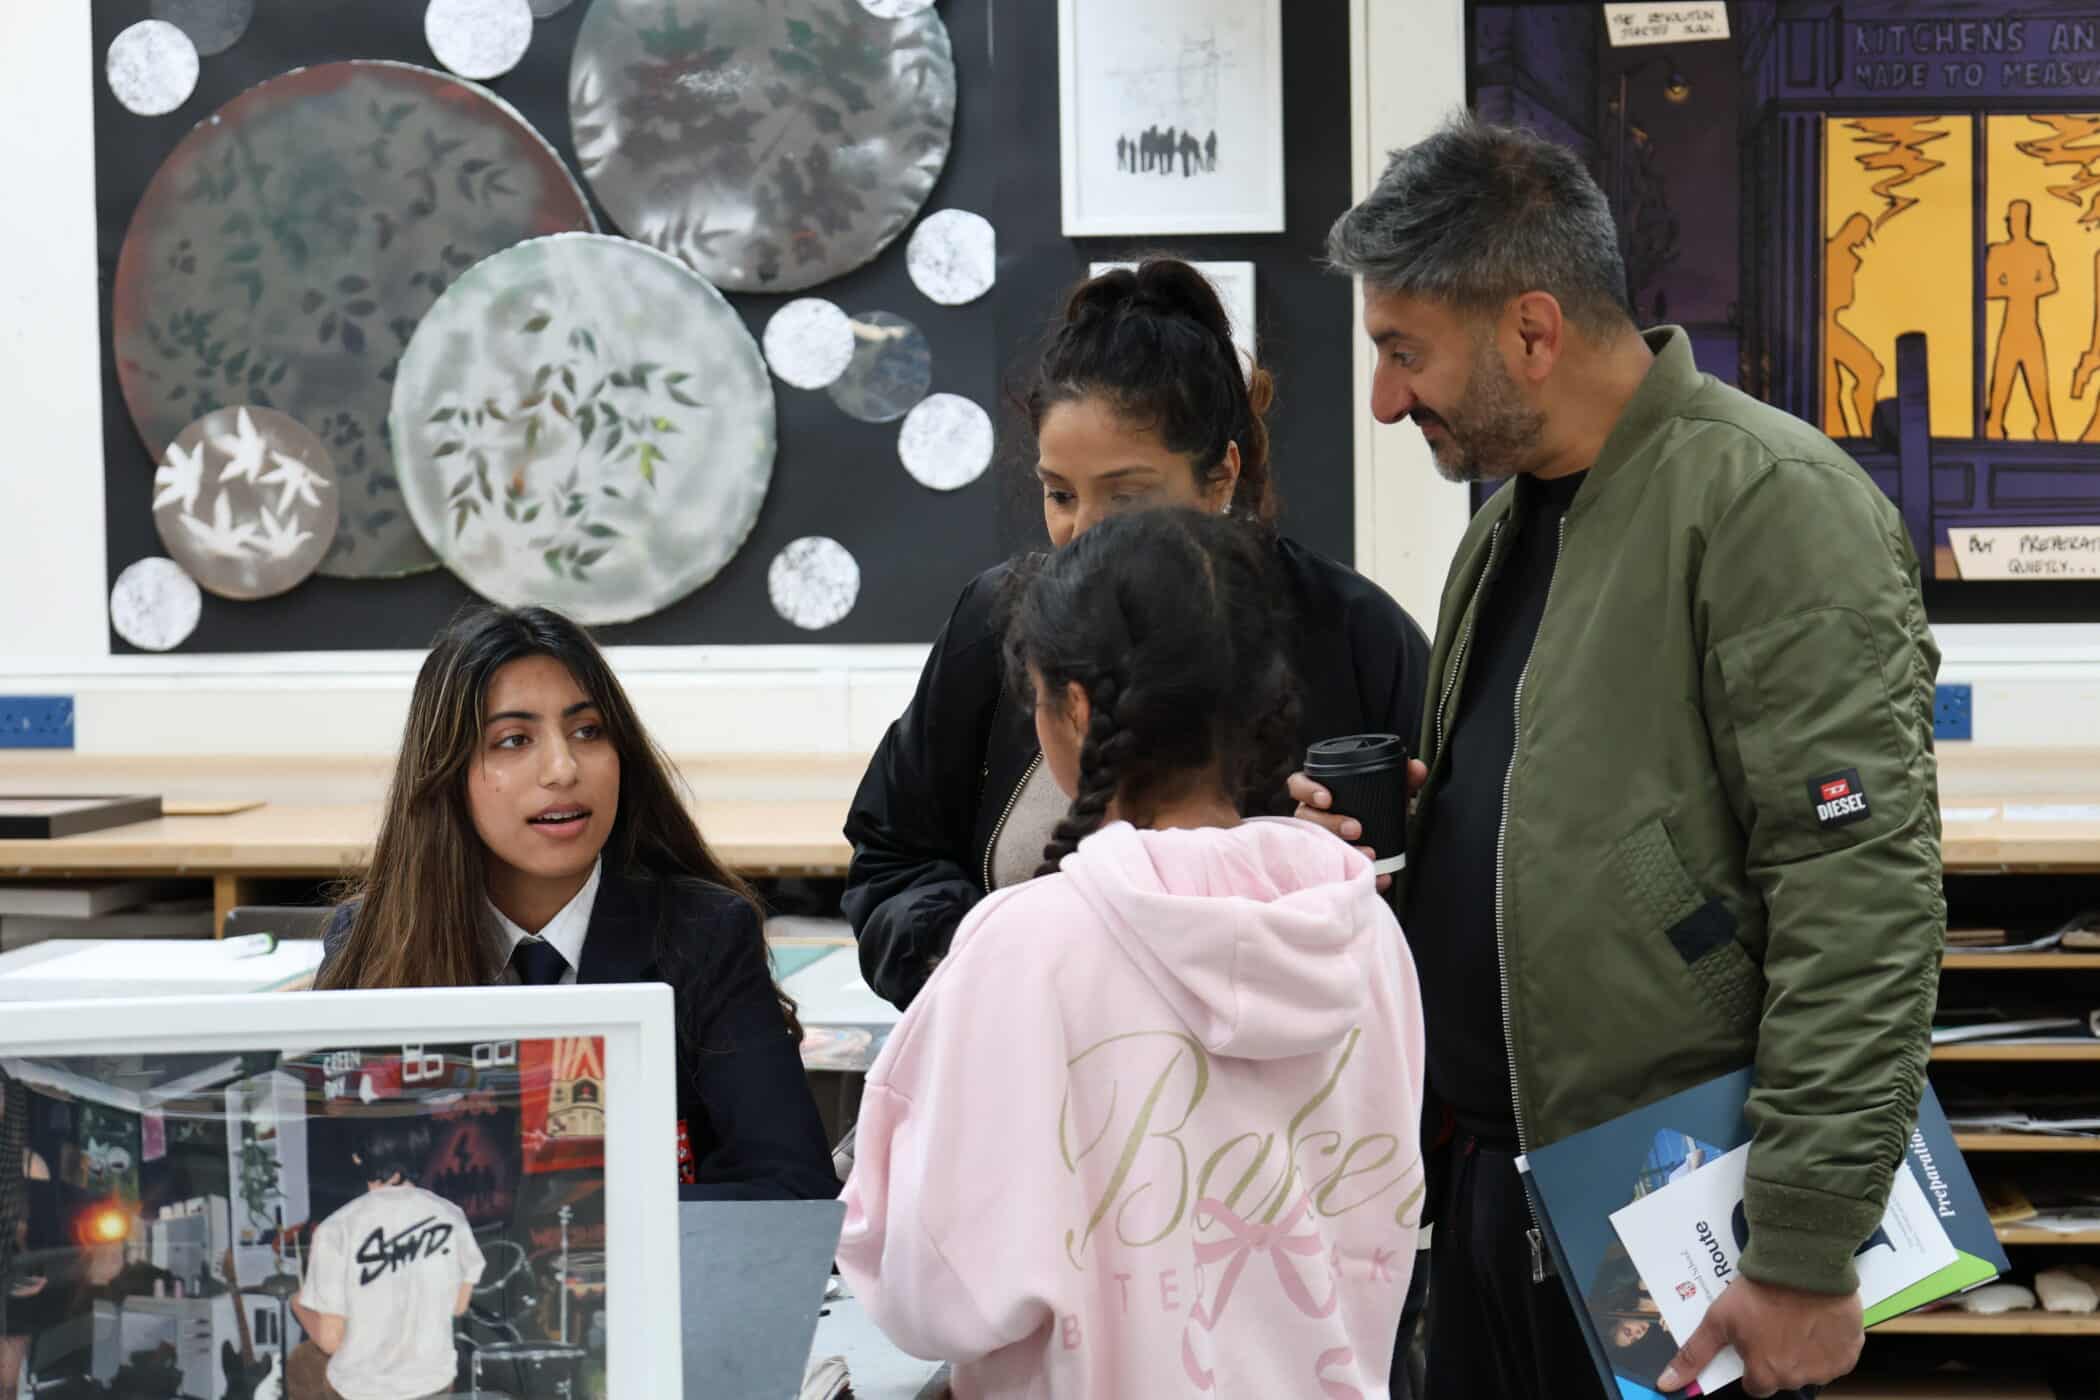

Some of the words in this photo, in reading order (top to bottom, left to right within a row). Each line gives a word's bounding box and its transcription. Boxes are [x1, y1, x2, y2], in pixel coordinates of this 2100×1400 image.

[1855, 21, 2025, 52] KITCHENS
[2050, 22, 2096, 52] AN
[1855, 63, 1927, 88] MADE
[1943, 63, 1984, 87] TO
[2002, 62, 2100, 86] MEASU
[1816, 792, 1866, 821] DIESEL
[1909, 1128, 1956, 1218] Preparatio
[1696, 1220, 1732, 1278] Route
